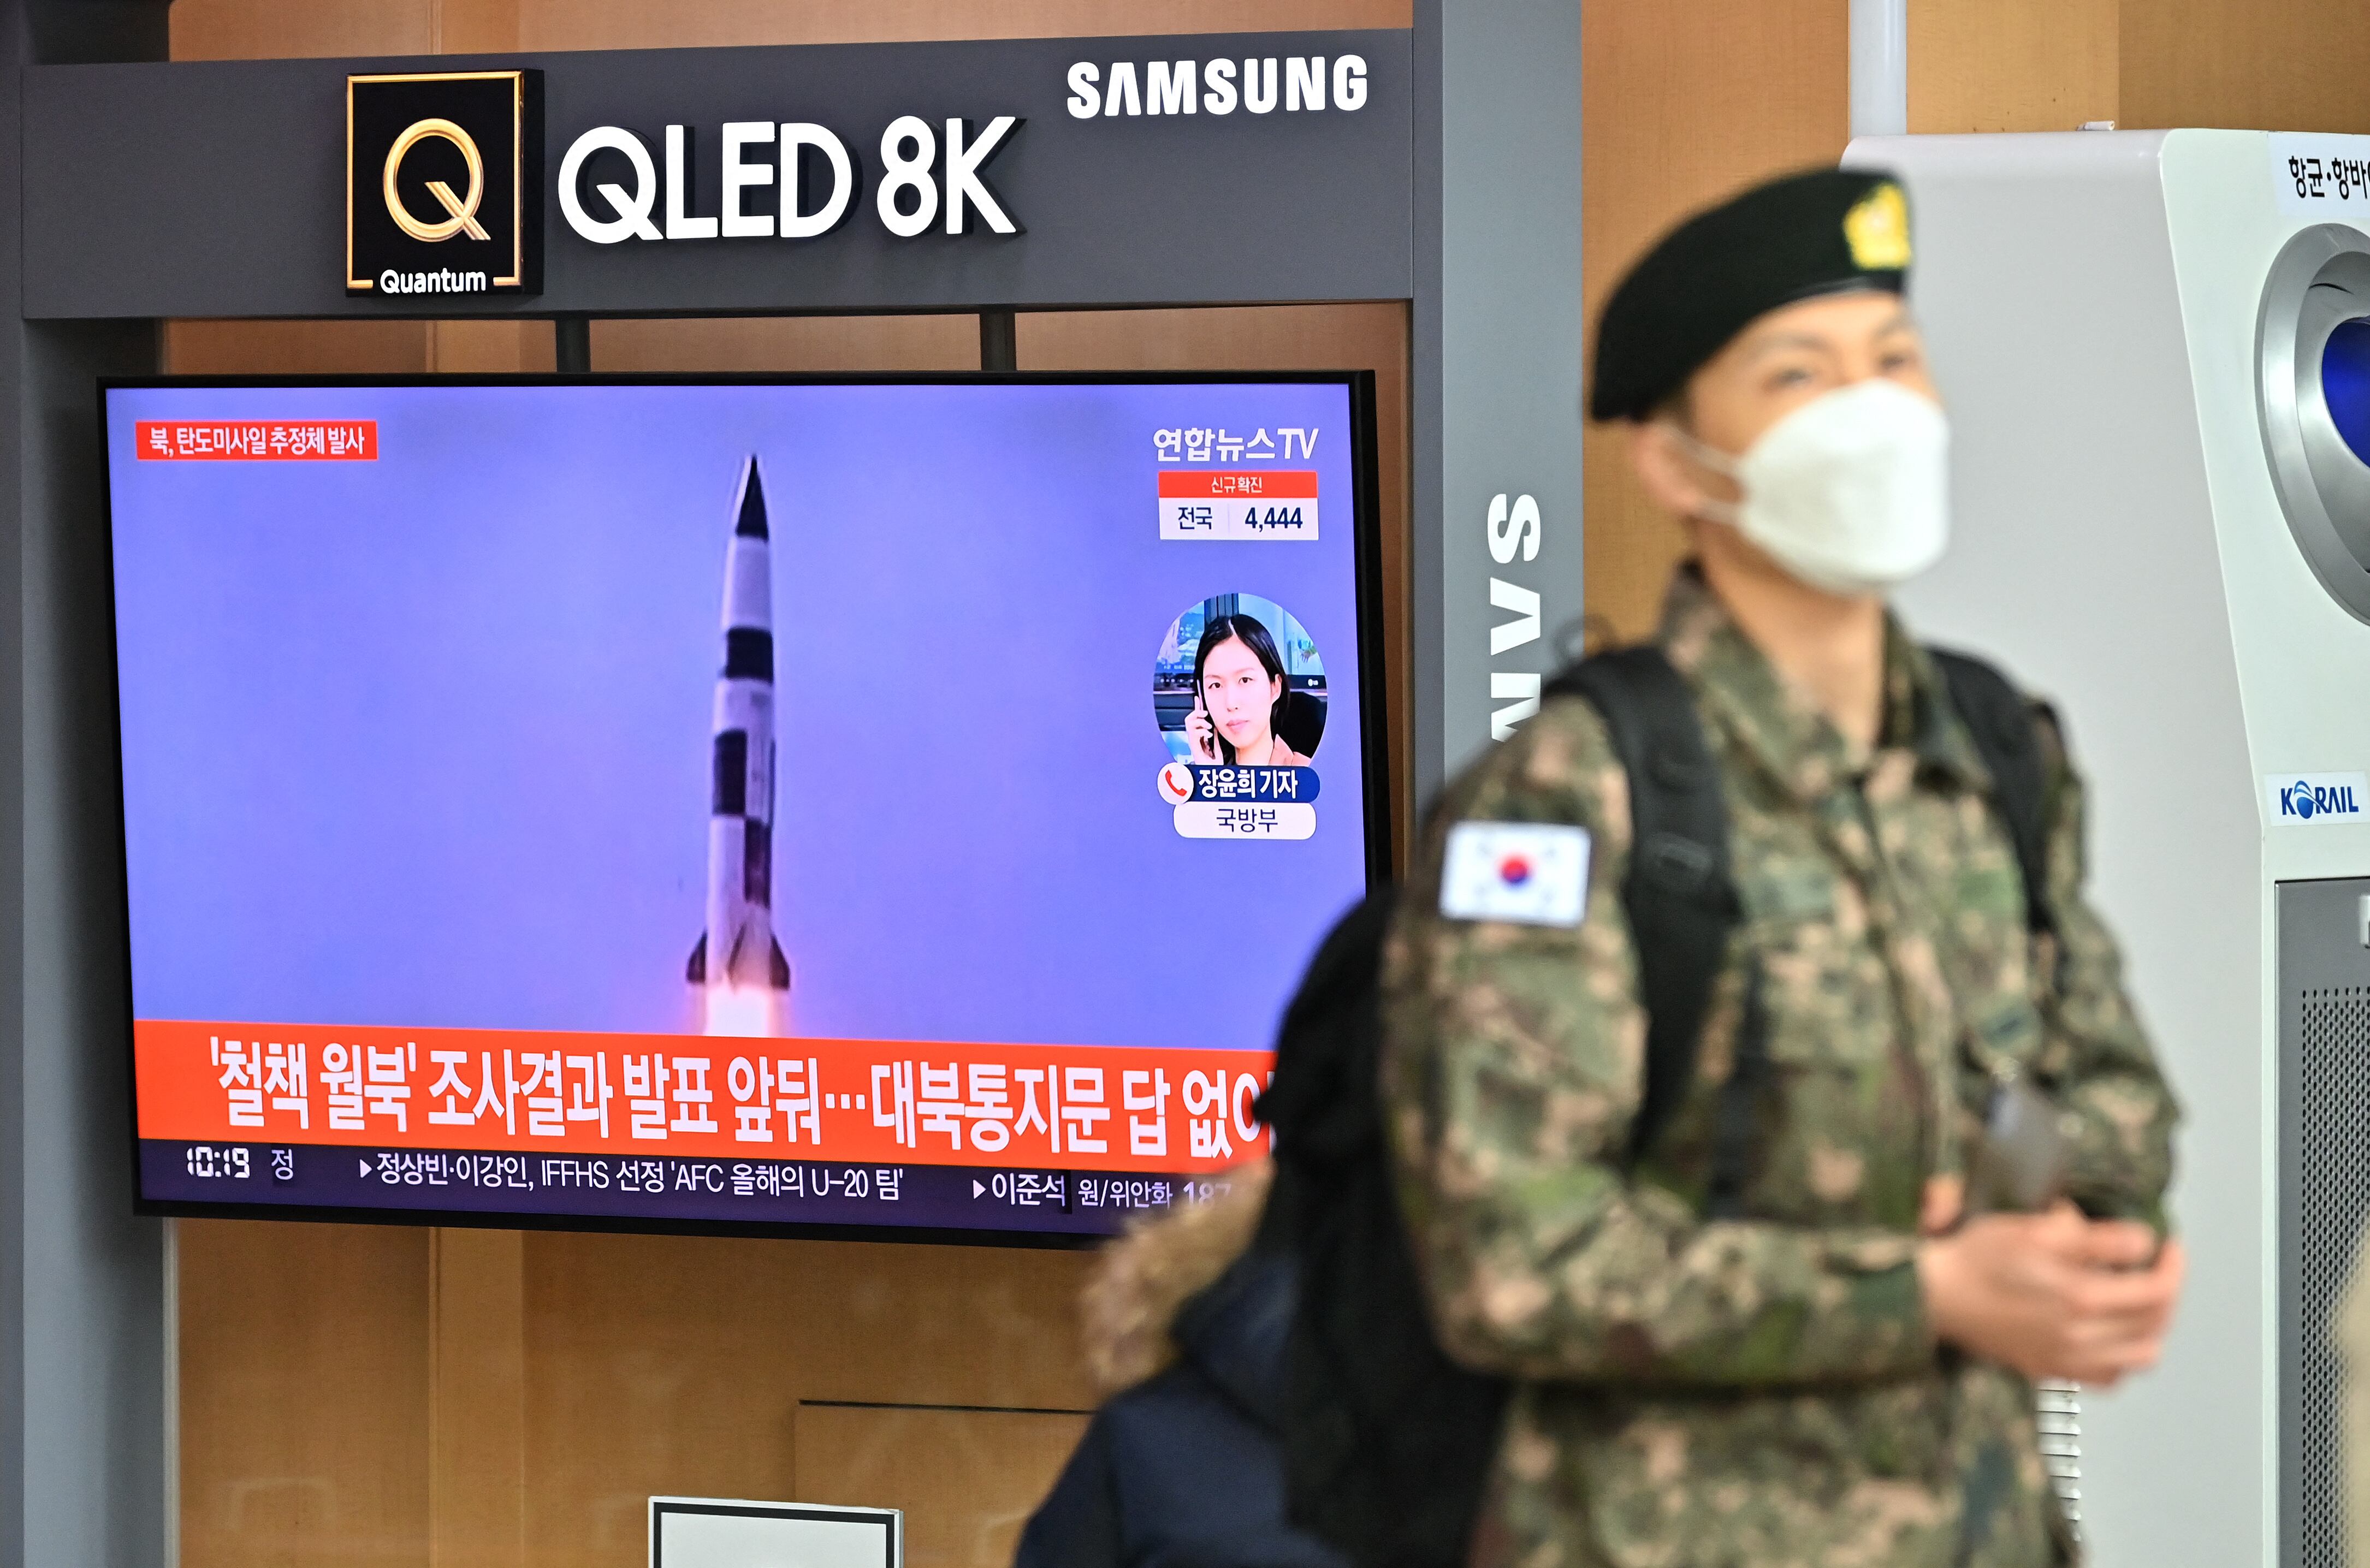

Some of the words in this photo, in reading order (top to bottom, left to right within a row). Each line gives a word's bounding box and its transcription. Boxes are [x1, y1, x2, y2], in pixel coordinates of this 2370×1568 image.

[1067, 54, 1367, 119] SAMSUNG
[383, 118, 491, 243] Q
[558, 121, 852, 243] QLED
[877, 115, 1016, 237] 8K
[2288, 156, 2370, 200] 항균·항바
[380, 268, 486, 294] Quantum
[150, 427, 174, 458] 북,
[176, 426, 266, 455] 탄도미사일
[270, 426, 325, 455] 추정체
[328, 426, 365, 455] 발사
[1178, 507, 1212, 530] 전국
[1245, 507, 1303, 532] 4,444
[1487, 493, 1541, 743] SAM
[1199, 768, 1255, 799] 장윤희
[1260, 768, 1297, 799] 기자
[1216, 808, 1278, 833] 국방부
[210, 1036, 309, 1130] '철책
[319, 1042, 416, 1132] 월북'
[428, 1048, 613, 1139] 조사결과
[623, 1053, 718, 1140] 발표
[1123, 1067, 1171, 1156] 답
[186, 1147, 250, 1178] 10:19
[271, 1149, 294, 1180] 정
[377, 1152, 534, 1191] 정상빈·이강인,
[541, 1160, 609, 1189] IFFHS
[615, 1160, 665, 1194] 선정
[671, 1161, 724, 1193] 'AFC
[730, 1164, 804, 1198] 올해의
[812, 1169, 868, 1198] U-20
[876, 1168, 904, 1201] 팀'
[992, 1172, 1065, 1207] 이준석
[1078, 1179, 1173, 1209] 원/위안화
